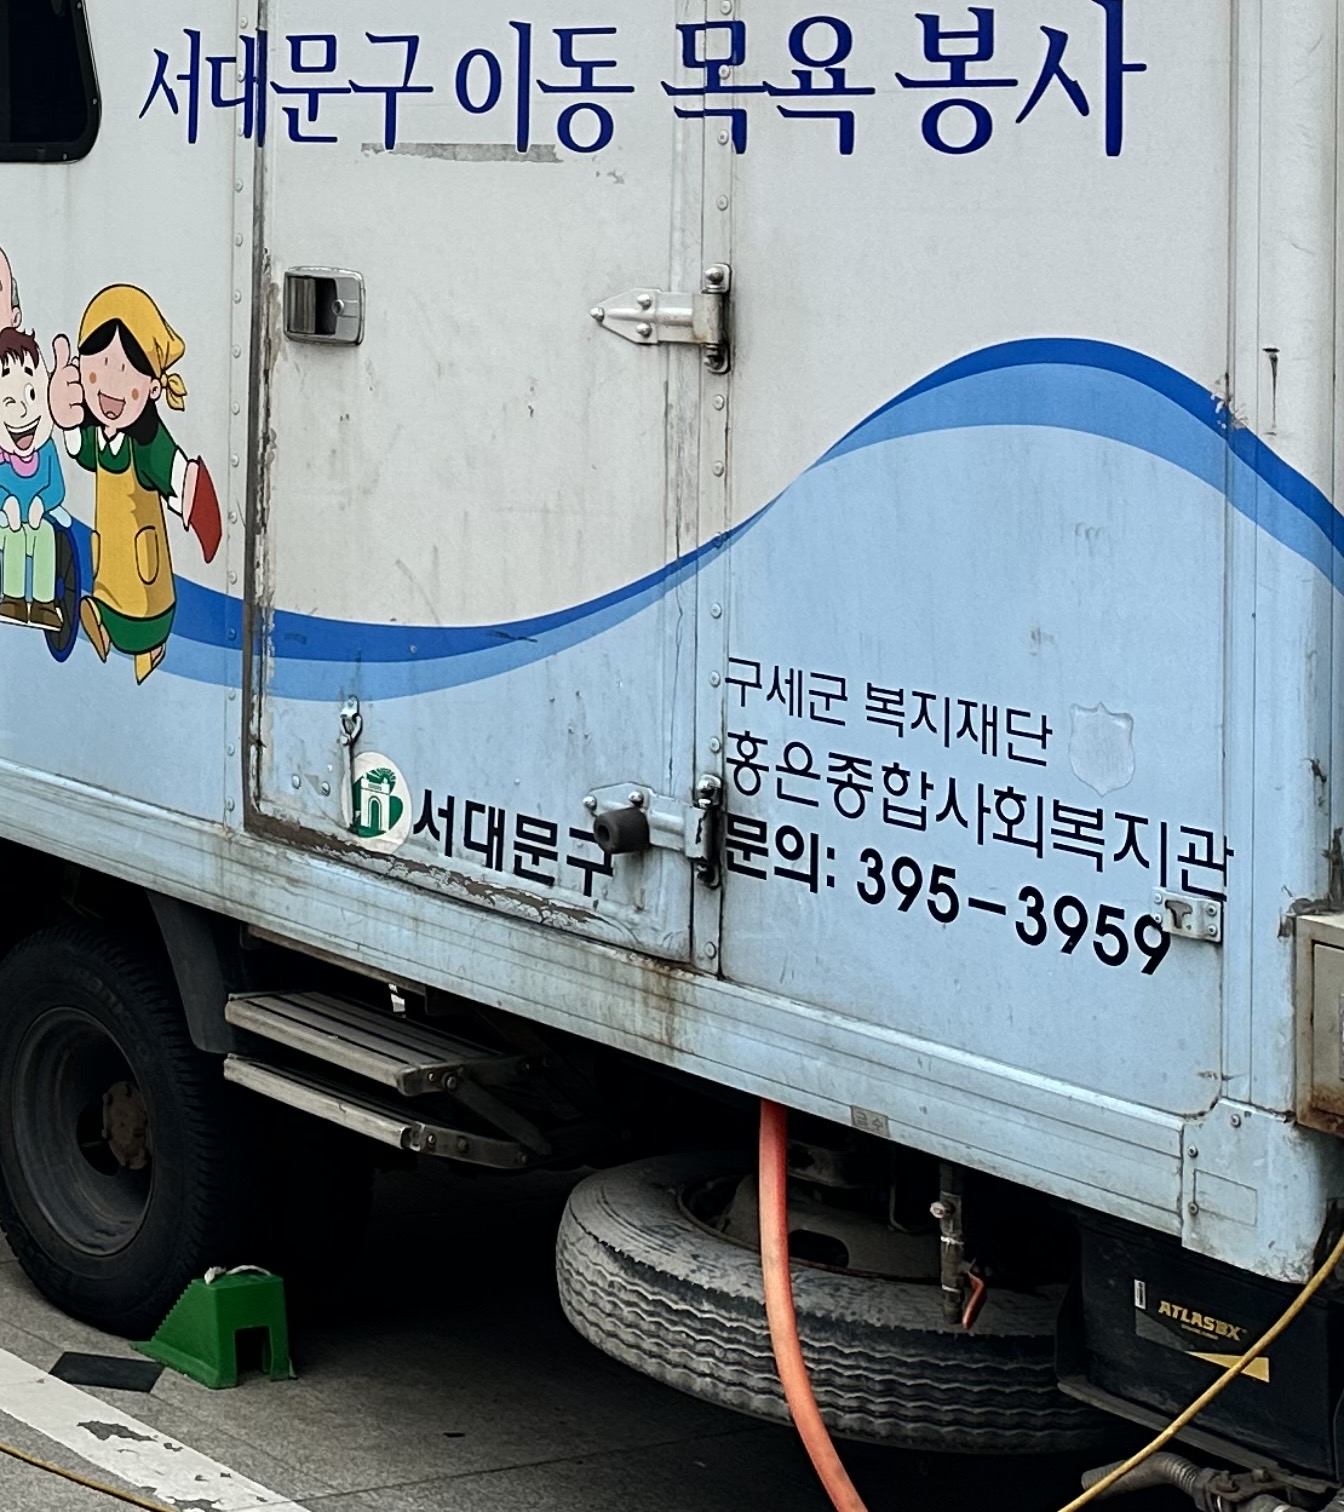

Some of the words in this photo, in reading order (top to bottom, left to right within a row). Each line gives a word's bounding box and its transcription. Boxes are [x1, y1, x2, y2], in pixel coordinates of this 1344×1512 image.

[139, 29, 434, 150] 서대문구
[455, 20, 635, 154] 이동
[661, 15, 875, 155] 목욕
[725, 657, 848, 726] 구세군
[865, 682, 1052, 767] 복지재단
[413, 789, 614, 897] 서대문구
[726, 730, 1234, 902] 홍은종합사회복지관
[725, 813, 835, 894] 문의:
[857, 848, 1171, 975] 395-3959
[1158, 1300, 1243, 1341] ATLASBX
